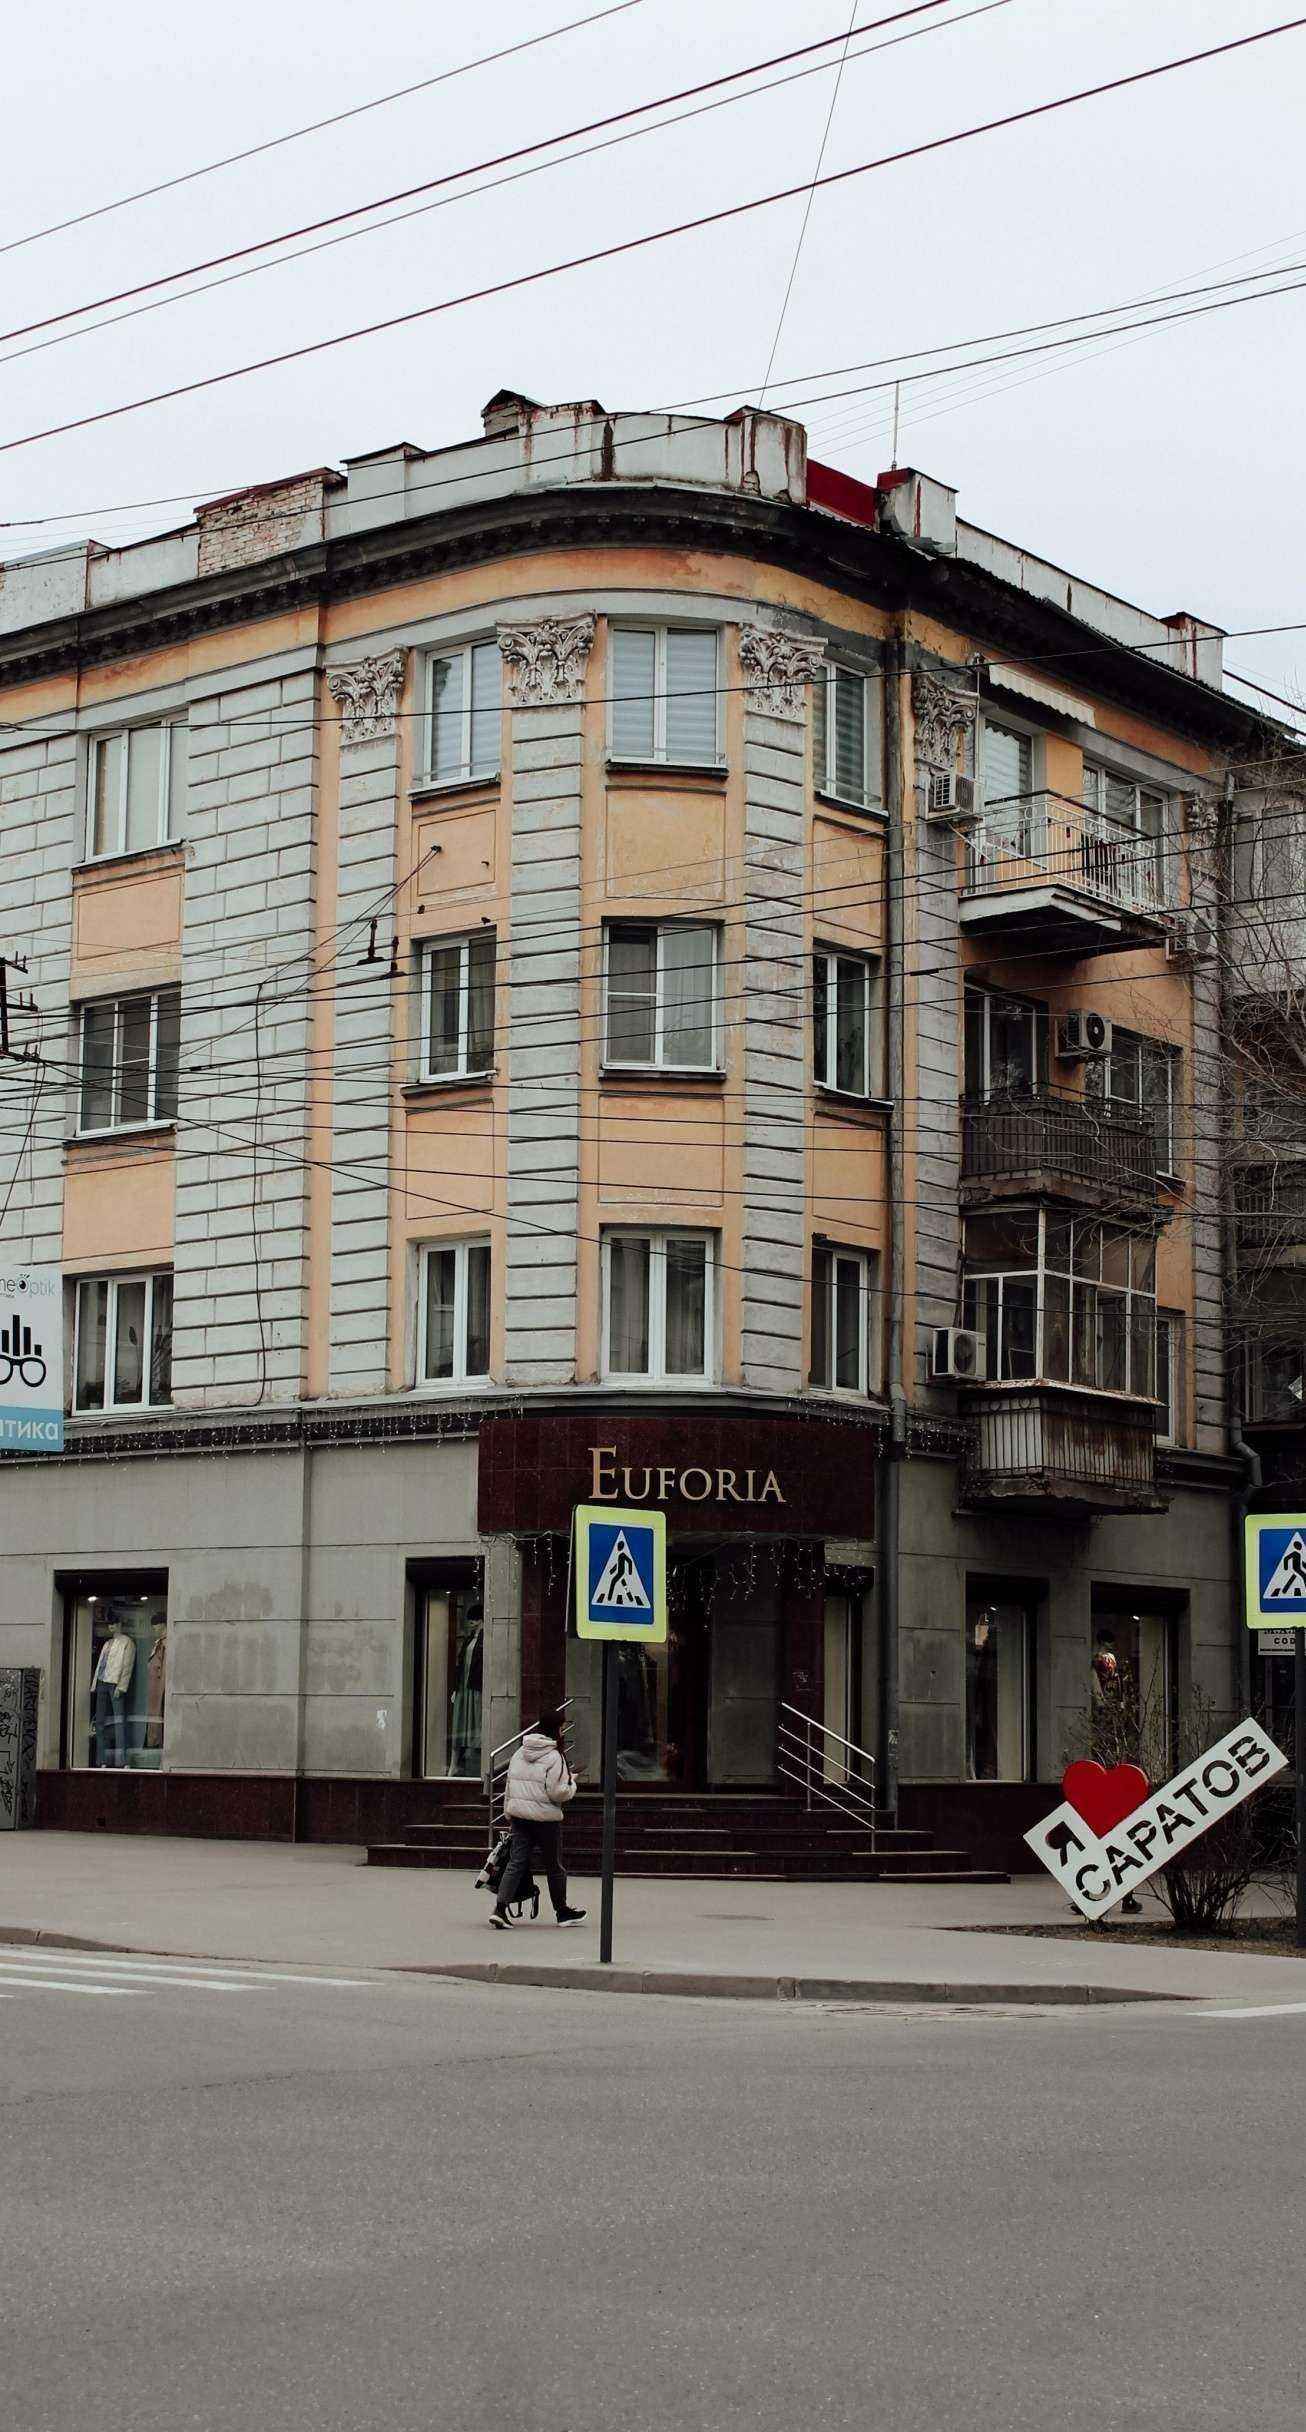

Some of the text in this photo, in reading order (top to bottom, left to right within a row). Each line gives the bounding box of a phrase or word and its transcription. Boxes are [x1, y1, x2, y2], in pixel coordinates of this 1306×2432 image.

[587, 1445, 787, 1503] EUFORIA
[1045, 1820, 1086, 1867] Я
[1075, 1735, 1271, 1902] САРАТОВ
